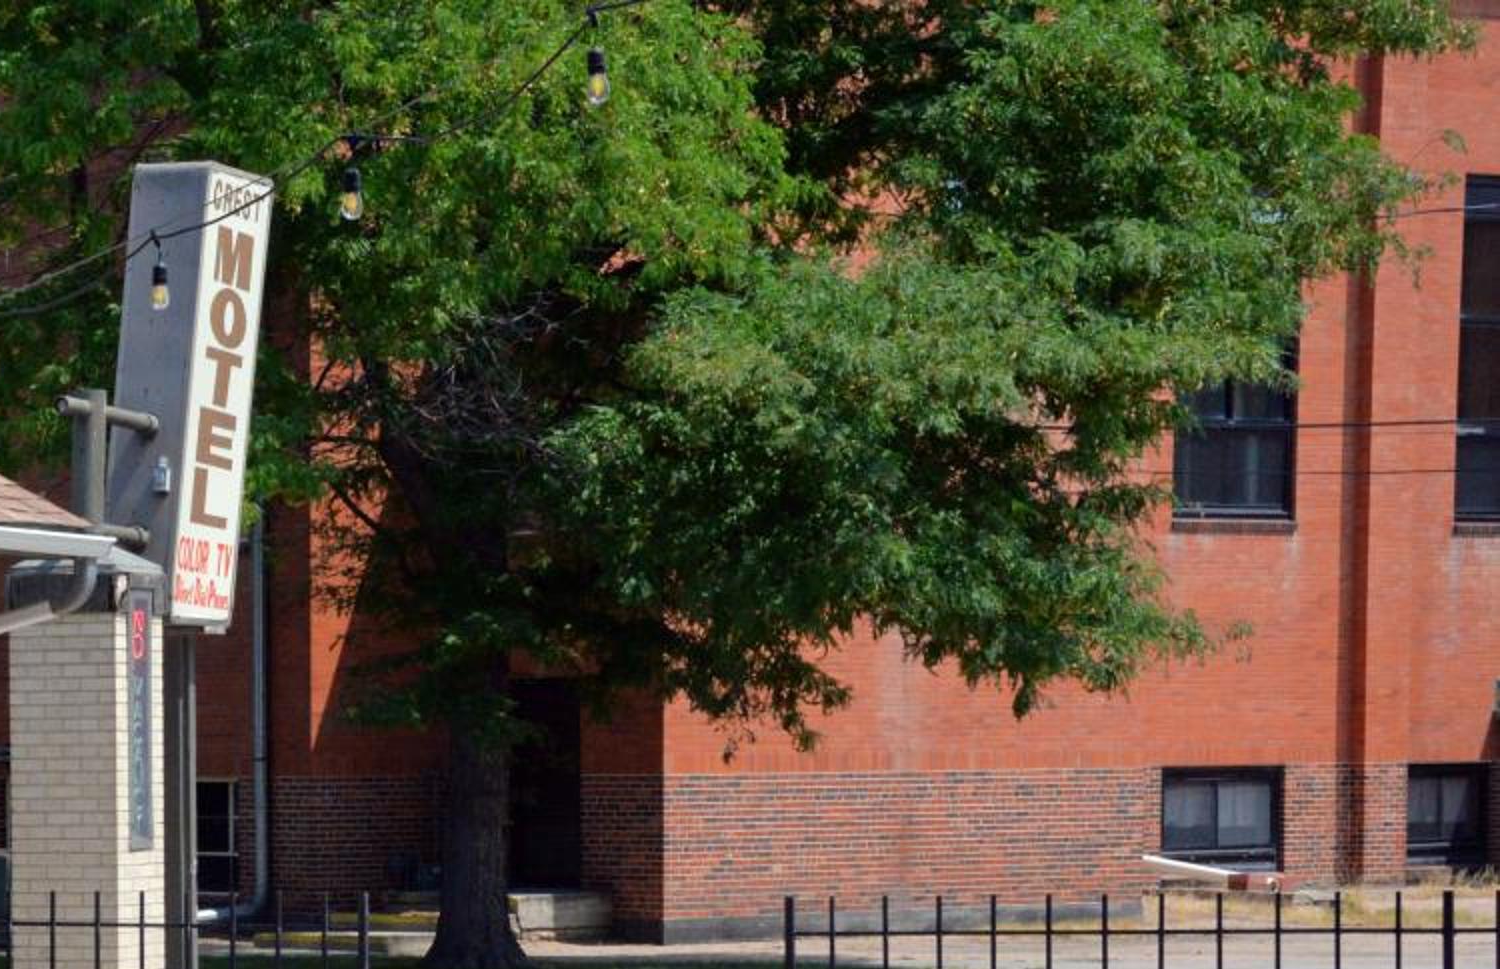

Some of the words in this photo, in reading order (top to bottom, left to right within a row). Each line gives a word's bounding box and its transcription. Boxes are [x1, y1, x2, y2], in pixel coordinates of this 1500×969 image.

[213, 179, 264, 224] CREST
[190, 225, 255, 530] MOTEL
[177, 535, 209, 573] COLOR
[217, 543, 232, 577] TV
[132, 608, 146, 659] NO
